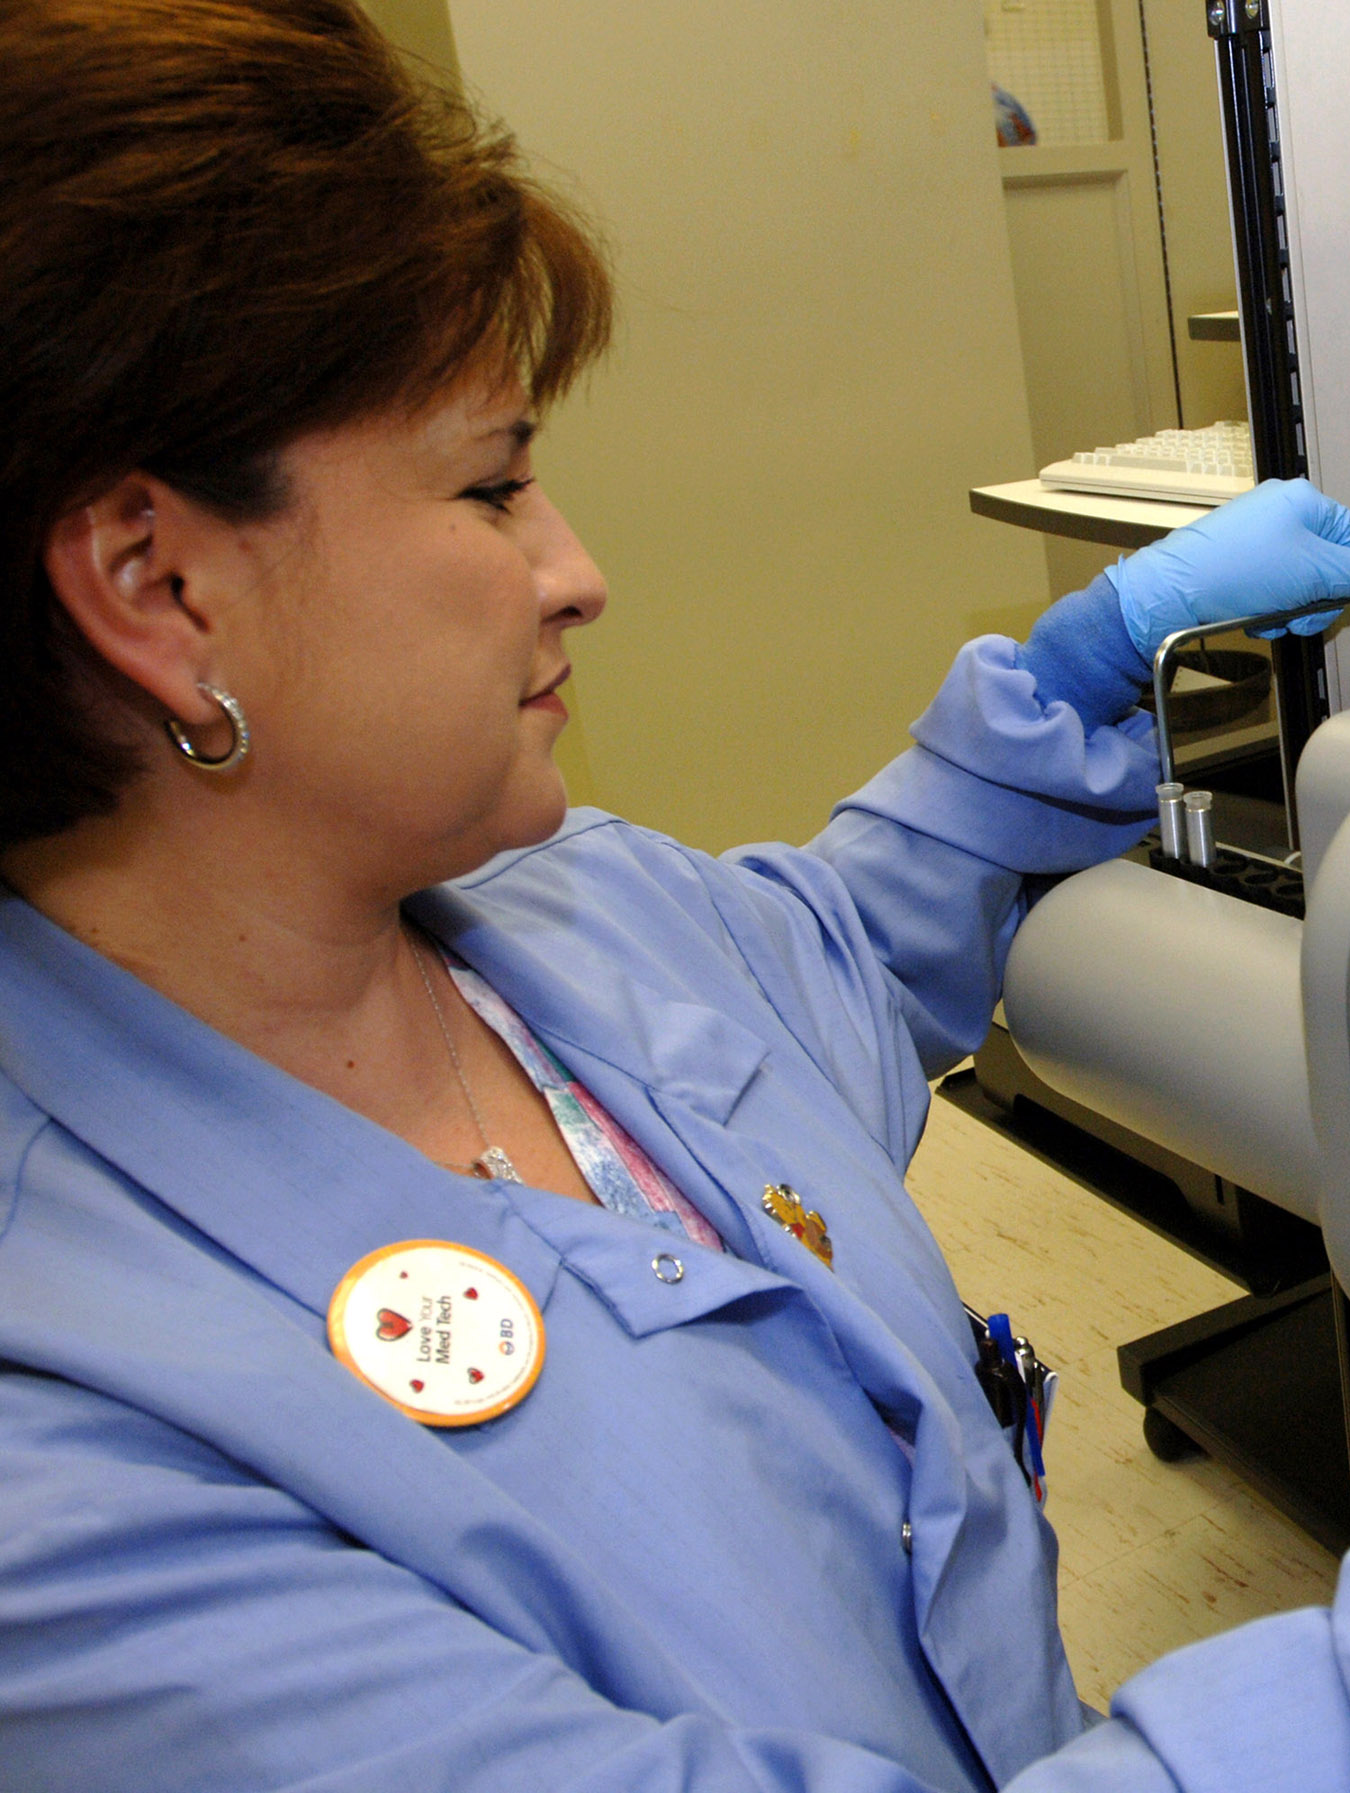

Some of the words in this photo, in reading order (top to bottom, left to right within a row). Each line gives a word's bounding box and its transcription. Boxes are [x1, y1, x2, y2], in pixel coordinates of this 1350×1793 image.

[436, 1295, 451, 1325] Tech
[500, 1318, 514, 1338] BD
[417, 1326, 431, 1363] Love
[435, 1331, 450, 1364] Med
